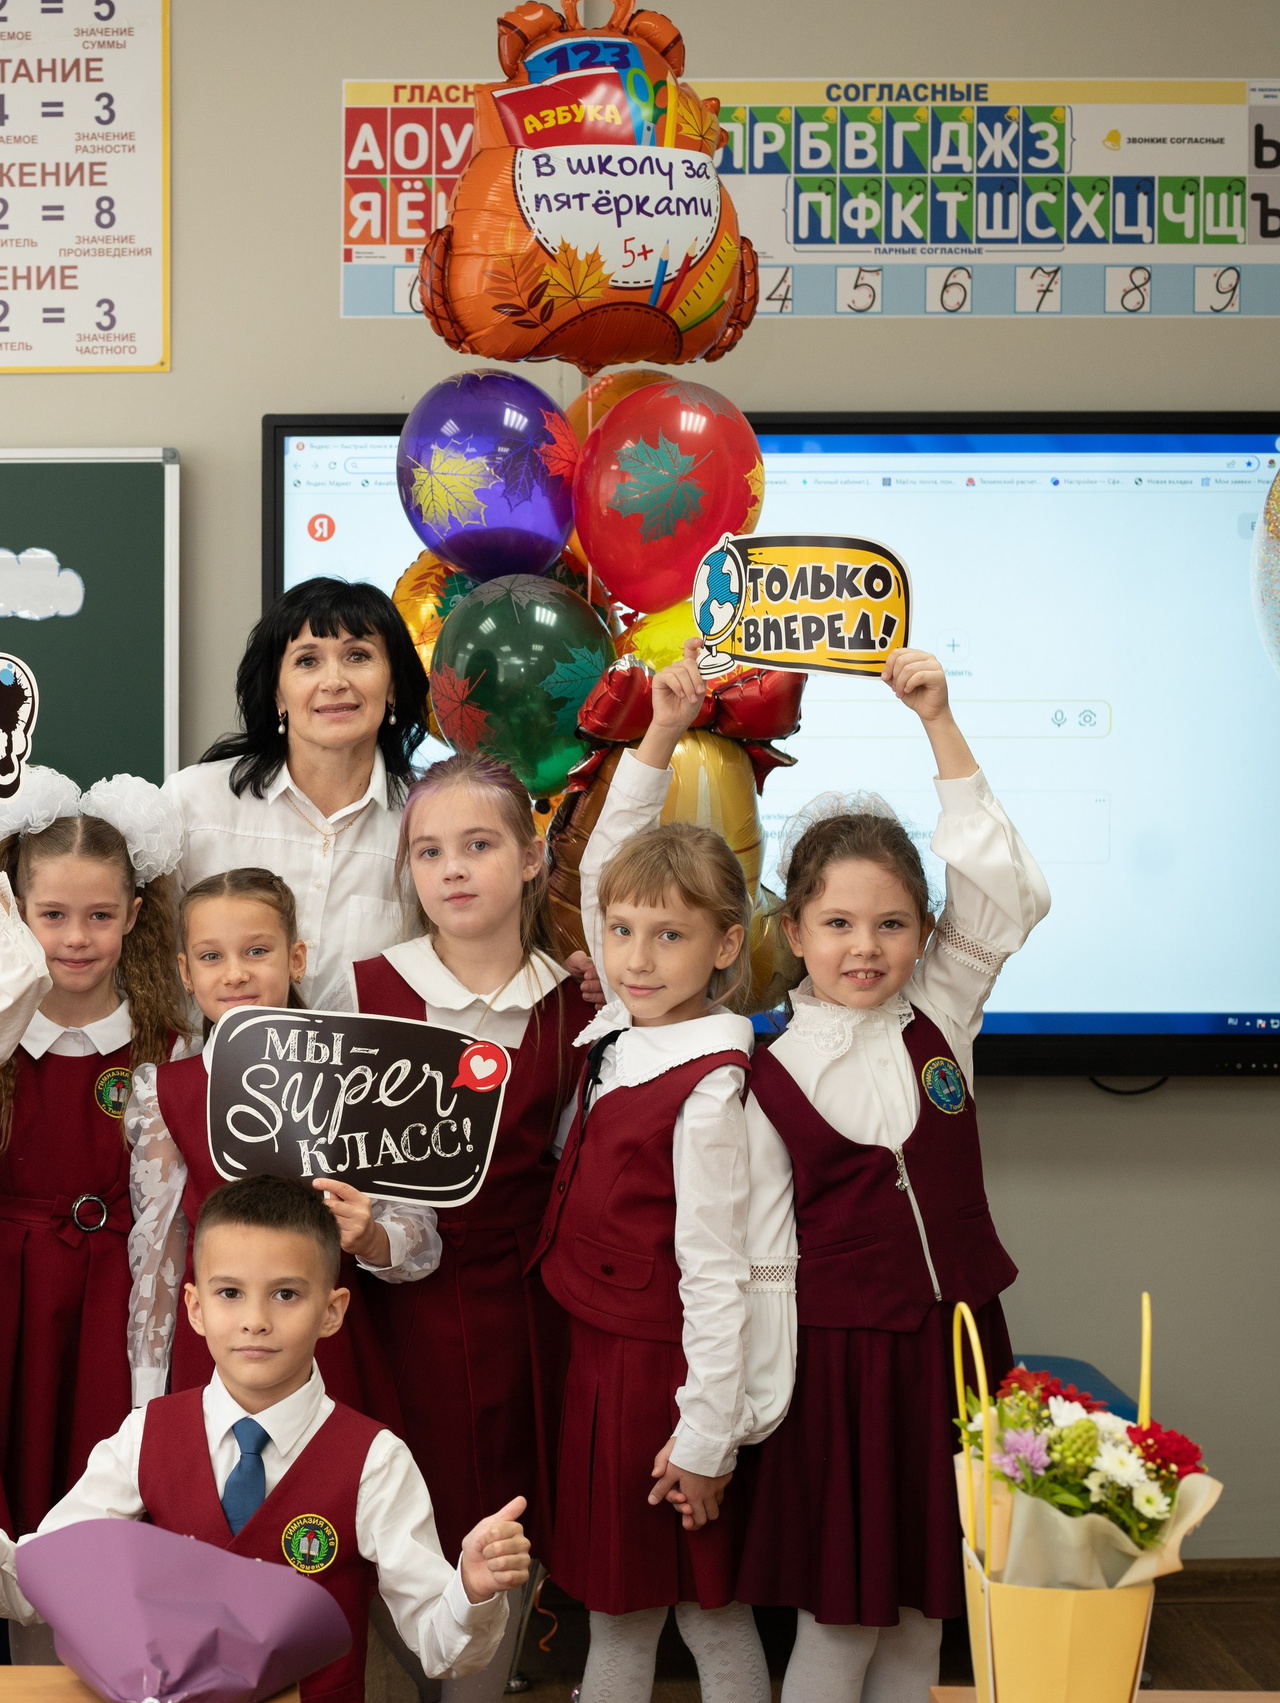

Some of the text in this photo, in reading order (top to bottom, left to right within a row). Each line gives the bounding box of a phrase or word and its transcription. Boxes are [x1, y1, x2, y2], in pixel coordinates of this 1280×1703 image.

[74, 26, 134, 37] ЗНАЧЕНИЕ
[82, 40, 126, 50] СУММЫ
[544, 43, 630, 73] 123
[825, 83, 989, 103] СОГЛАСНЫЕ
[94, 92, 116, 126] 3
[524, 104, 622, 134] АЗБУКА
[75, 131, 136, 142] ЗНАЧЕНИЕ
[75, 144, 136, 154] РАЗНОСТИ
[1126, 137, 1225, 145] ЗВОНКИЕ СОГЛАСНЫЕ
[533, 154, 710, 190] В школу за
[534, 190, 712, 228] пятёрками
[58, 247, 152, 258] ПРОИЗВЕДЕНИЯ
[75, 234, 136, 245] ЗНАЧЕНИЕ
[622, 237, 653, 268] 5+
[874, 247, 983, 255] ПАРНЫЕ СОГЛАСНЫЕ
[765, 266, 1240, 313] 4 5 6 7 8 9
[95, 298, 117, 332] 3
[75, 345, 137, 355] ЧАСТНОГО
[76, 332, 136, 343] ЗНАЧЕНИЕ
[748, 564, 893, 604] ТОЛЬКО
[743, 610, 899, 652] ВПЕРЕД!
[226, 1059, 458, 1152] Super
[297, 1117, 473, 1176] КЛАСС!
[285, 1517, 324, 1540] ГИМНАЗИЯ
